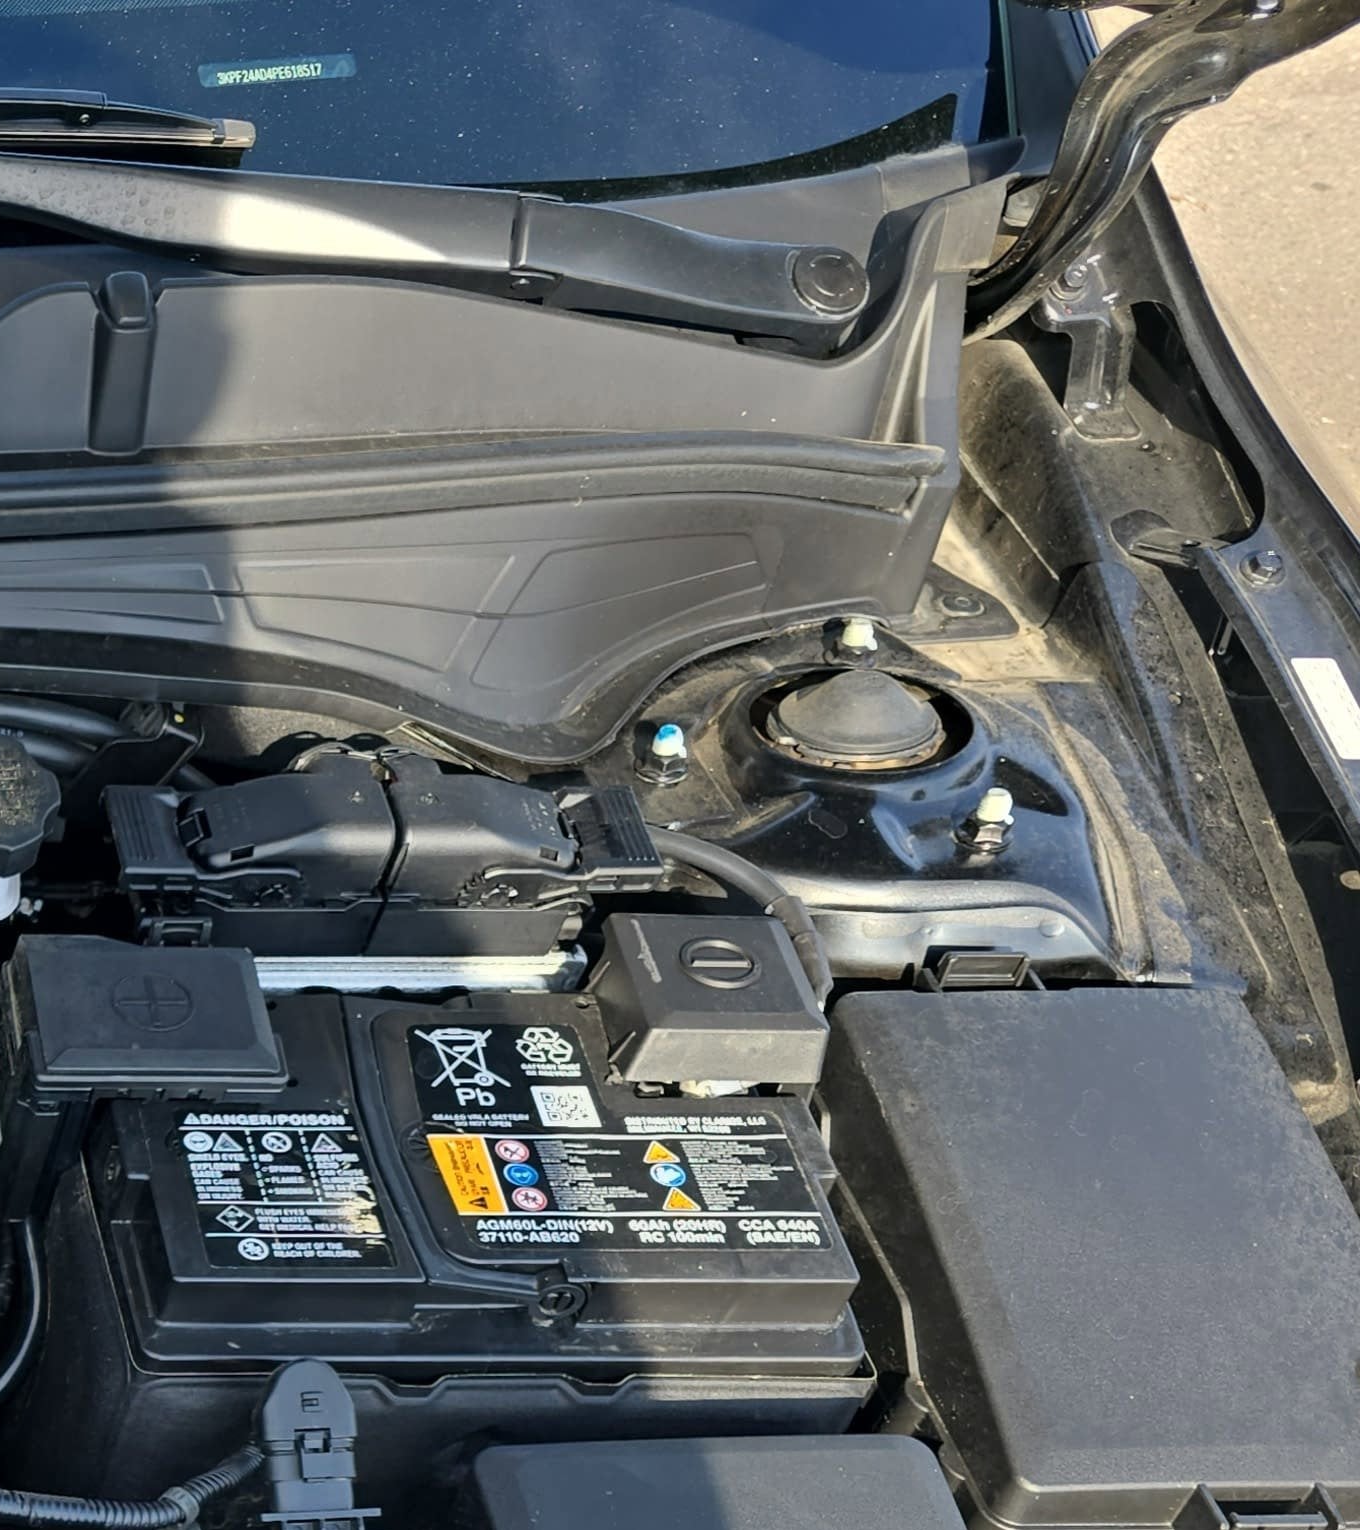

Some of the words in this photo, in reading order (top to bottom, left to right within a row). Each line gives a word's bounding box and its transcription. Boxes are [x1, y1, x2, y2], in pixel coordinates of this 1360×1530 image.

[455, 1087, 496, 1107] Pb
[199, 1113, 346, 1126] DANGER/POISON
[476, 1218, 614, 1234] AGM60L-DIN(12V)
[738, 1219, 776, 1231] CCA
[479, 1231, 580, 1243] 37110-AB620
